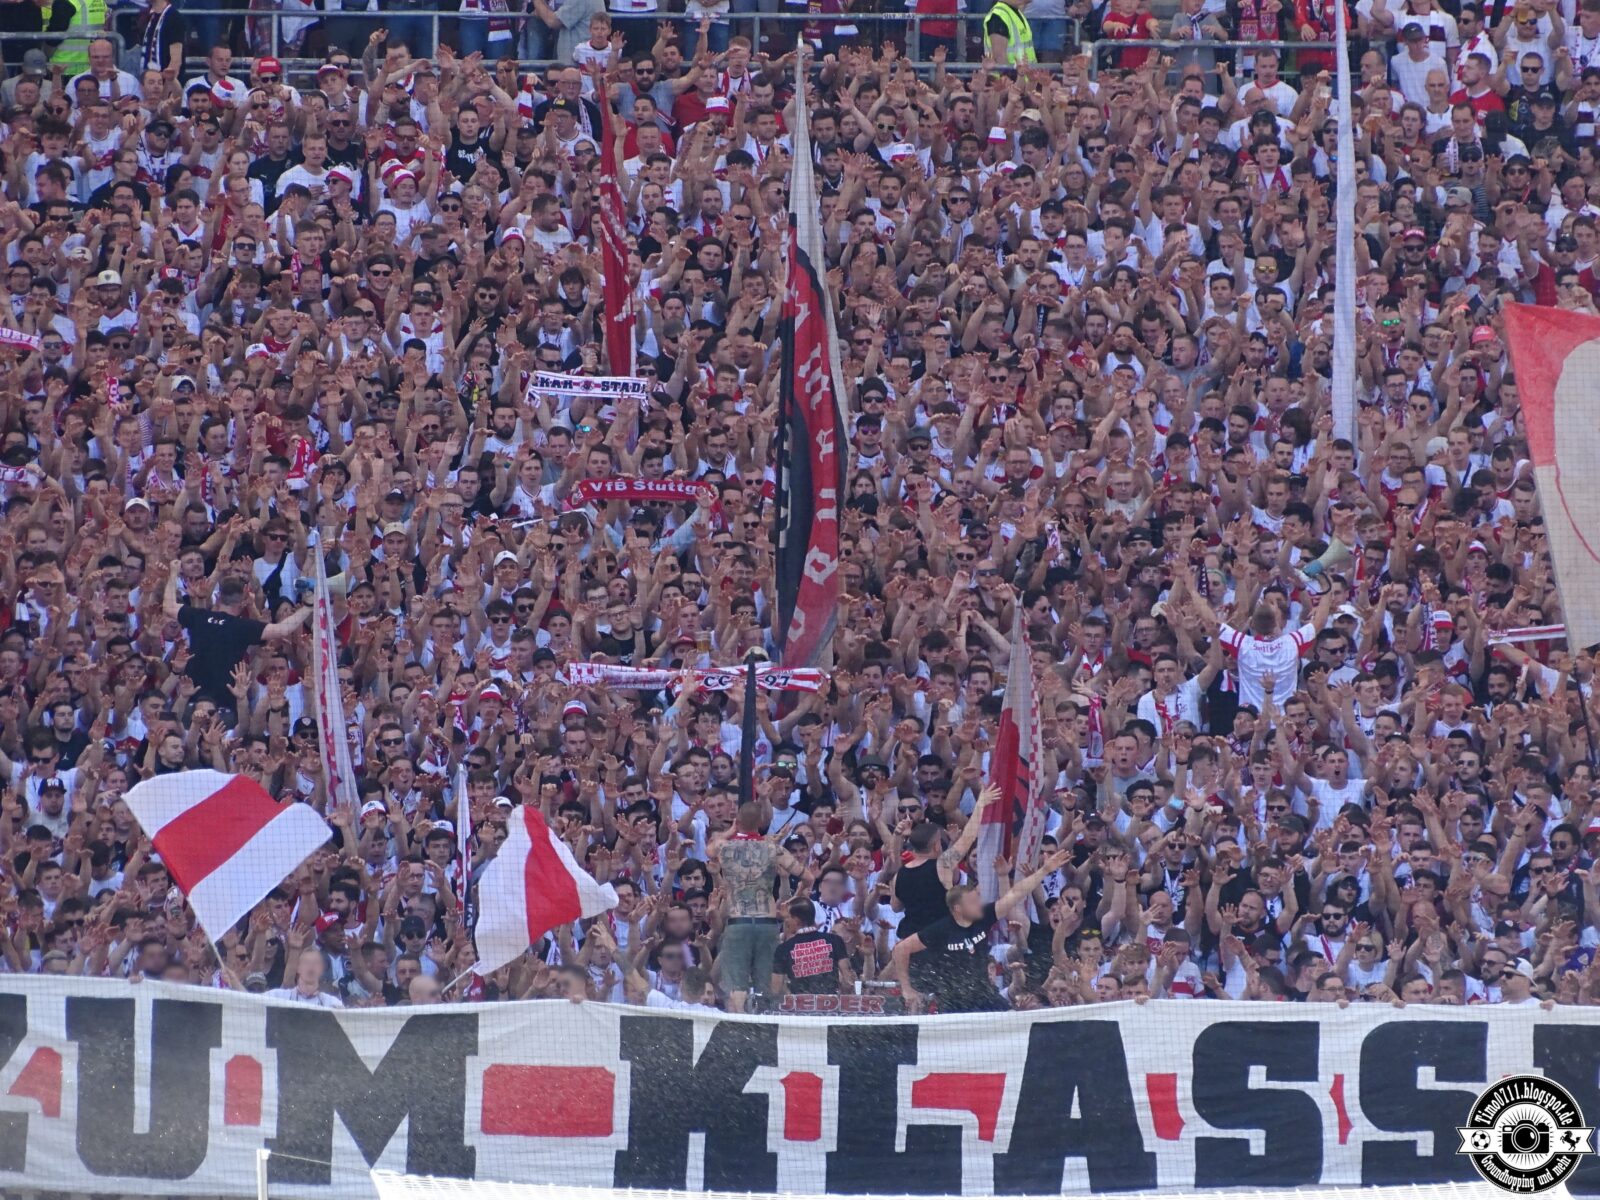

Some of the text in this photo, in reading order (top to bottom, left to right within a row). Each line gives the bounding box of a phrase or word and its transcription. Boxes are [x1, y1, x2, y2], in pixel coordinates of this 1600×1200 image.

[590, 480, 698, 495] VfB Stuttg
[765, 675, 790, 686] 97
[795, 940, 826, 951] JEDER
[779, 994, 886, 1013] JEDER
